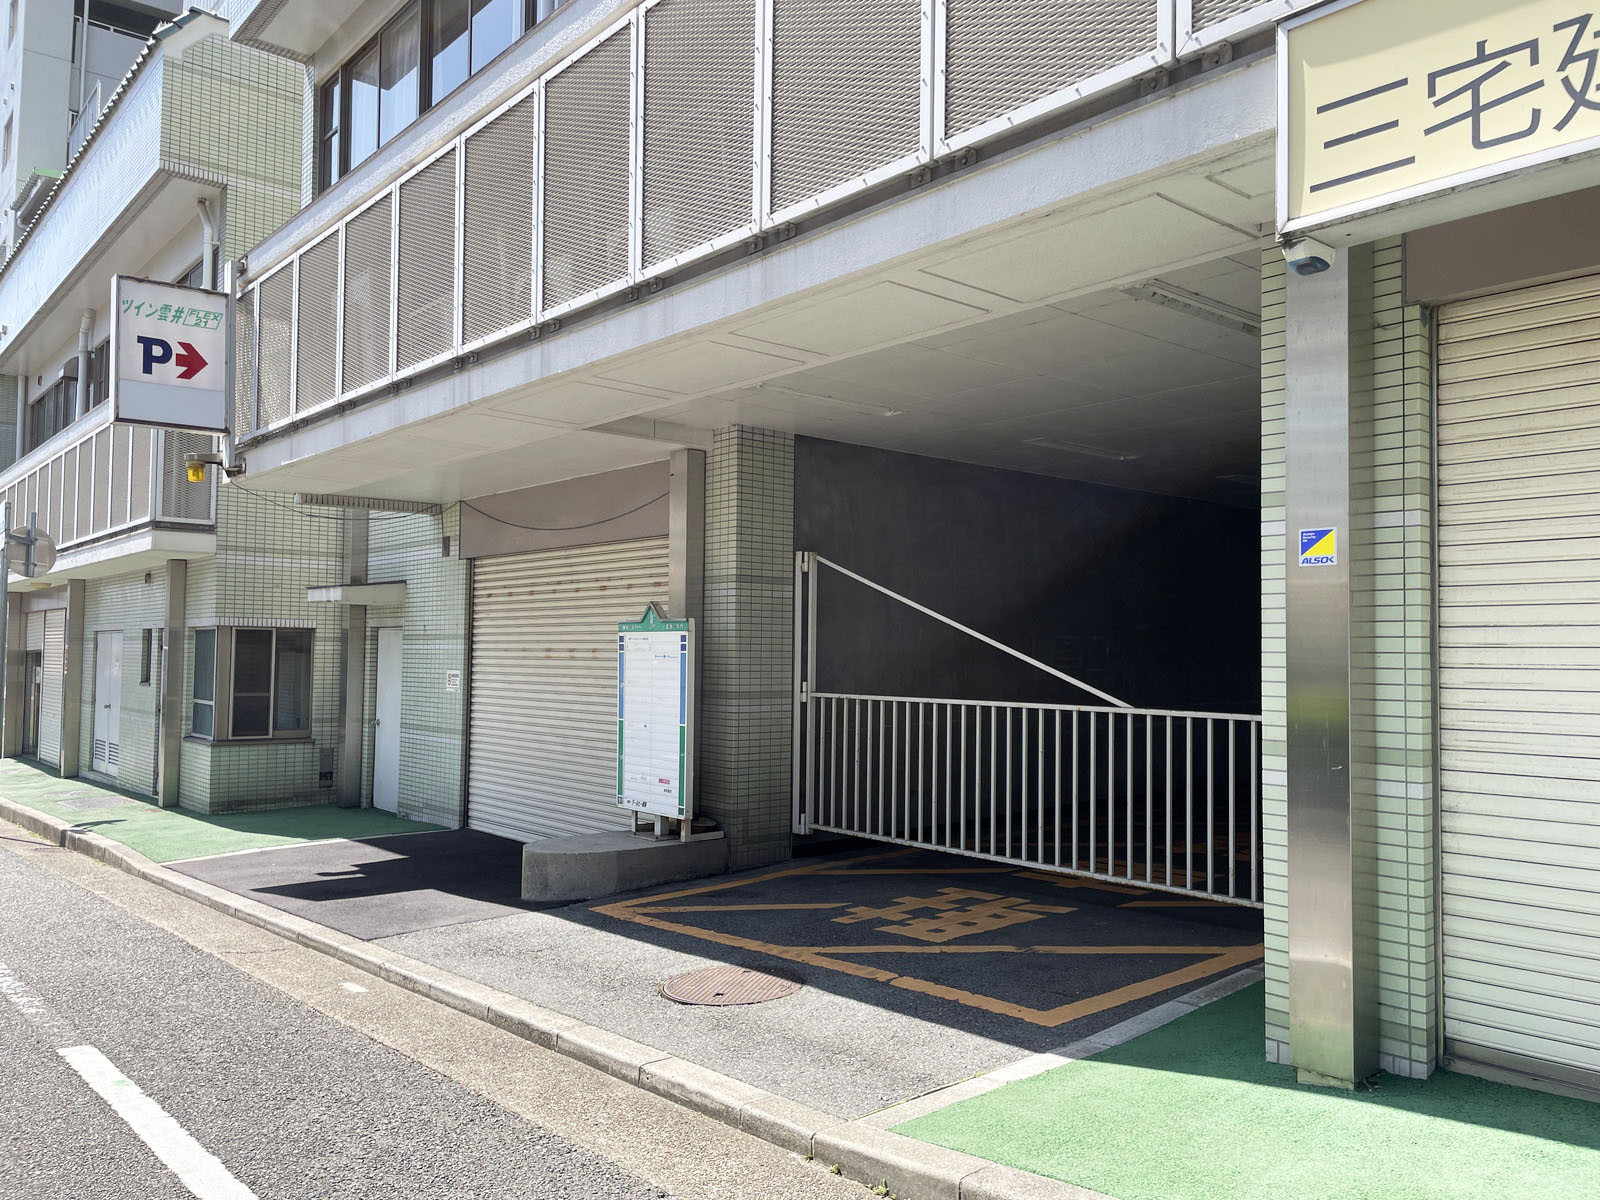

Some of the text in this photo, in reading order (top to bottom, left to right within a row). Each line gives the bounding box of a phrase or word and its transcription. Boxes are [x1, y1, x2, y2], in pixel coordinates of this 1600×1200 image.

[122, 299, 184, 324] ツイン雲井
[188, 309, 220, 321] FLEX
[194, 318, 209, 327] 21
[137, 335, 173, 375] P
[1301, 556, 1334, 565] ALSOK
